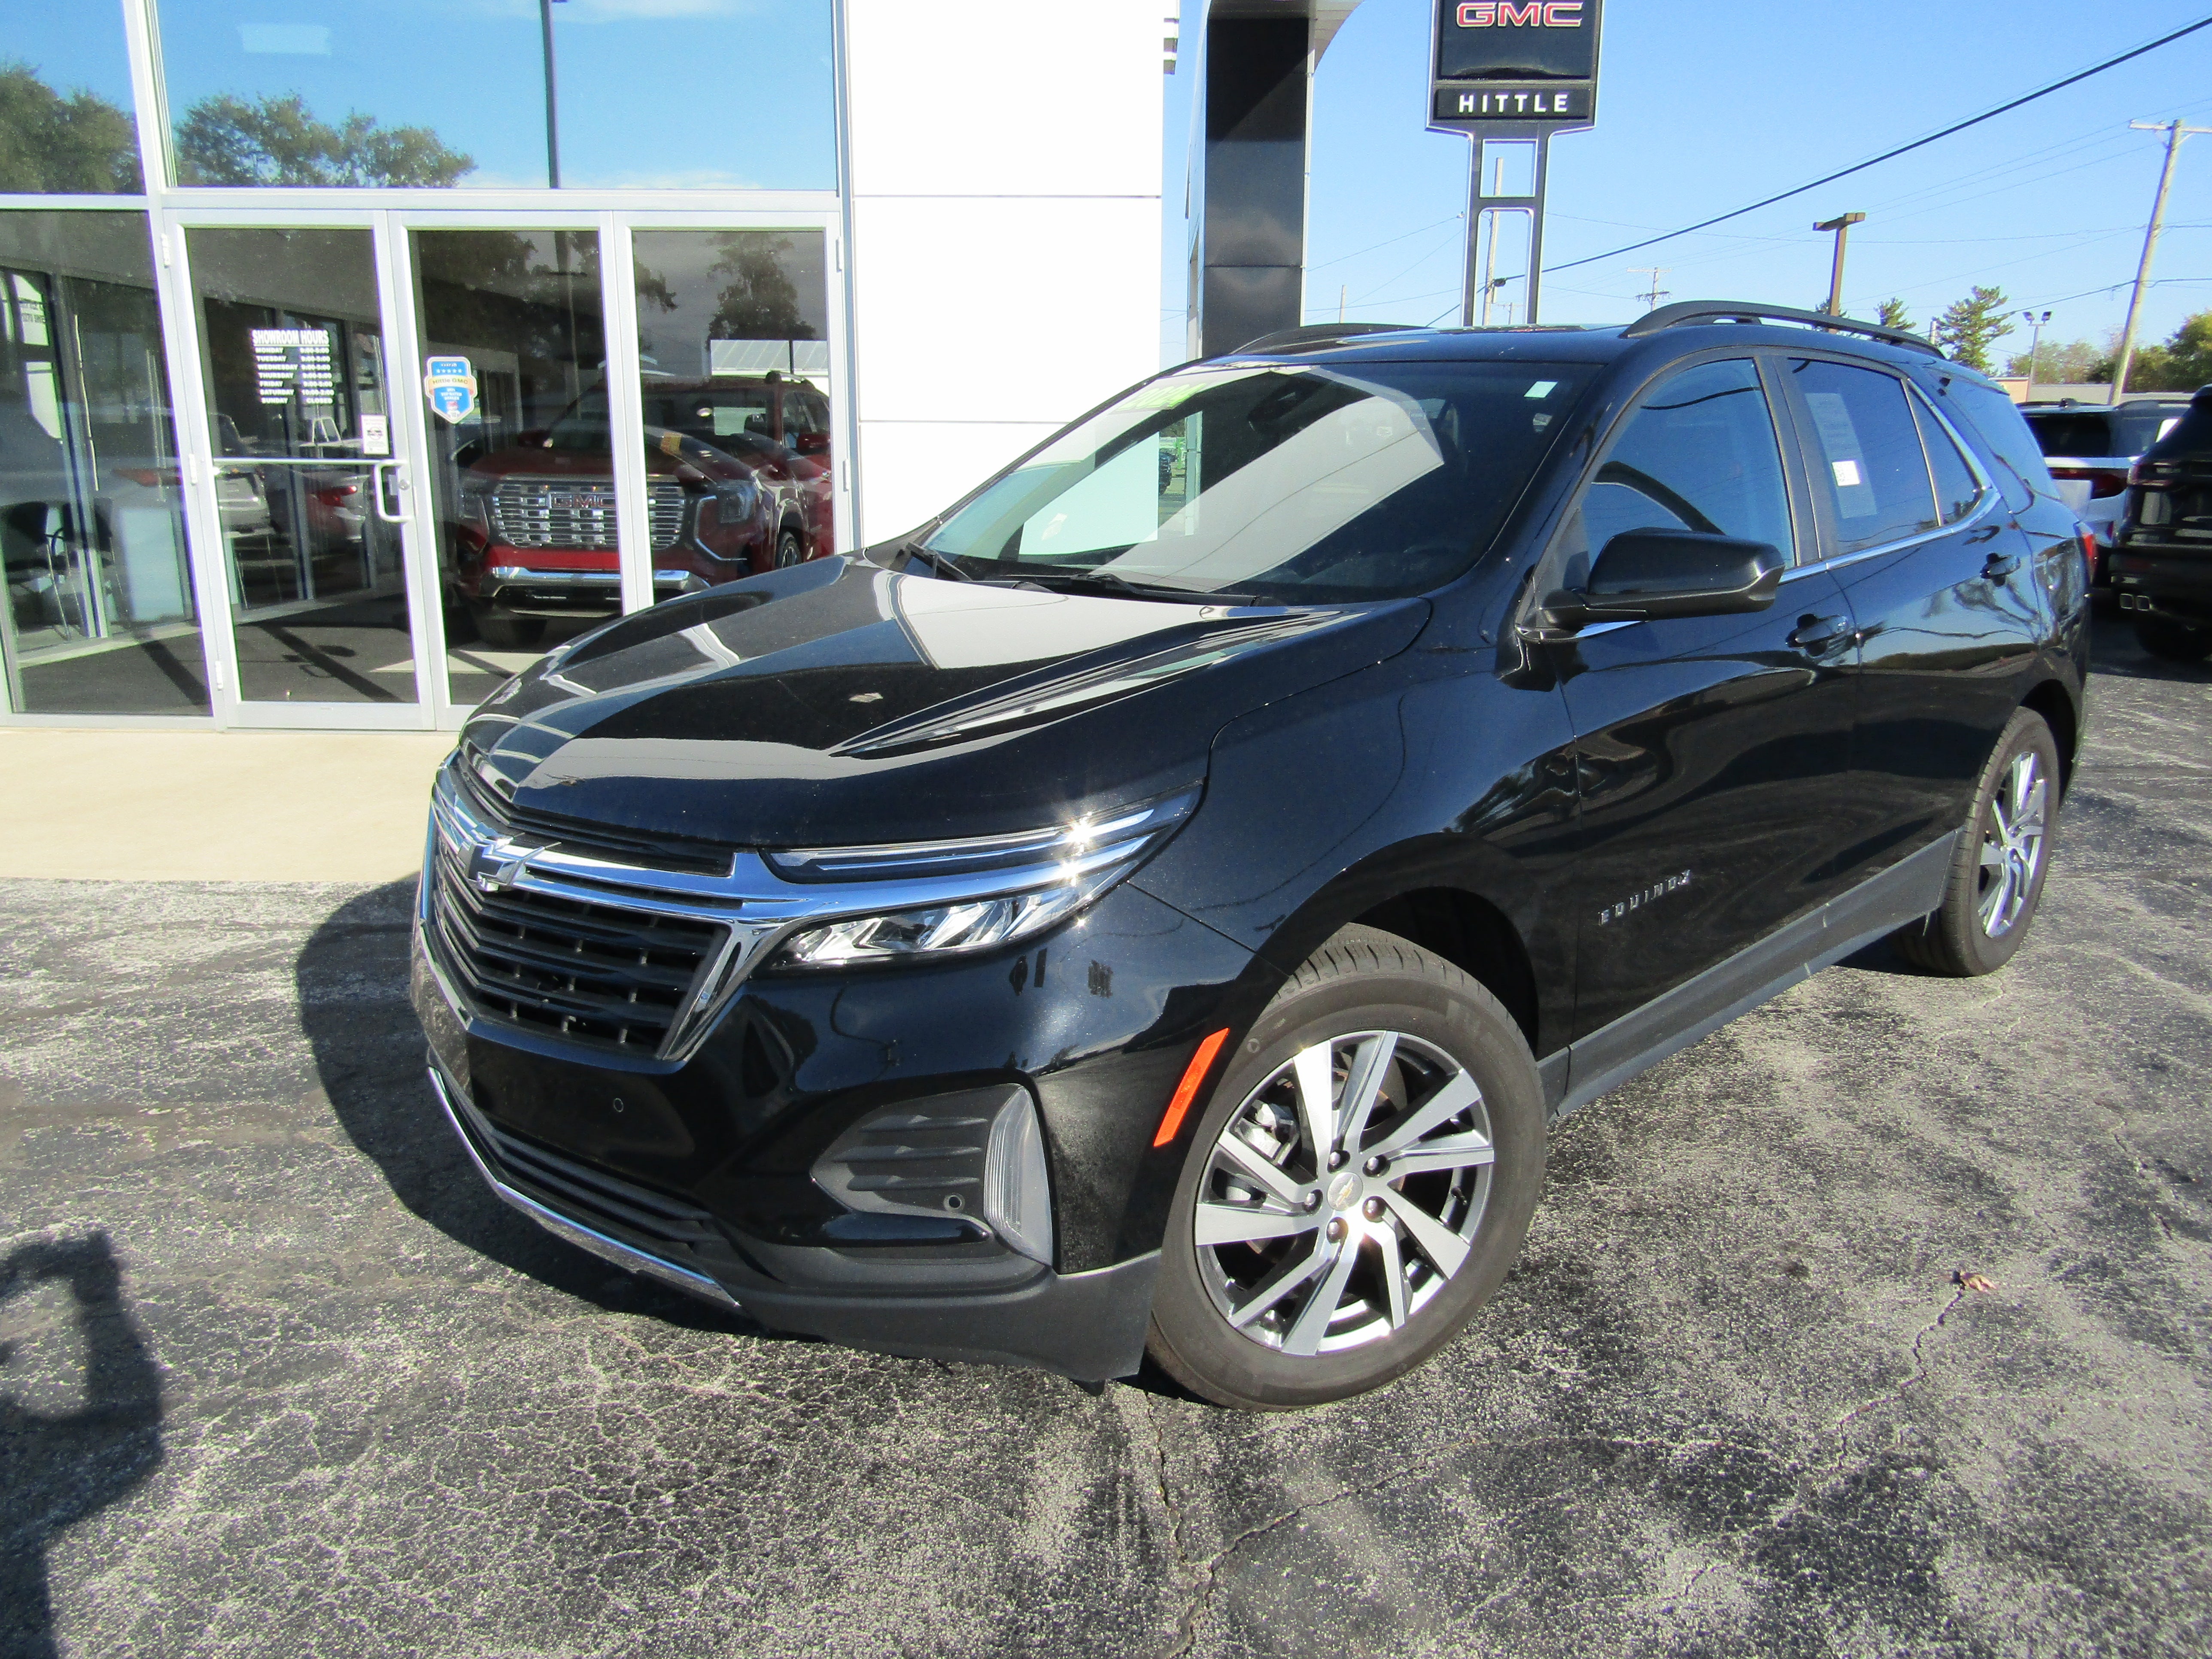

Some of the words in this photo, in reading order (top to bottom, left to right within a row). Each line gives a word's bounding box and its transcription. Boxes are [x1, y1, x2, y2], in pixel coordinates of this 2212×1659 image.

[1456, 2, 1584, 27] GMC
[1458, 94, 1568, 113] HITTLE
[251, 329, 300, 344] SHOWROOM
[300, 329, 329, 344] HOURS
[552, 495, 616, 508] GMC
[1598, 869, 1691, 926] EQUINOX
